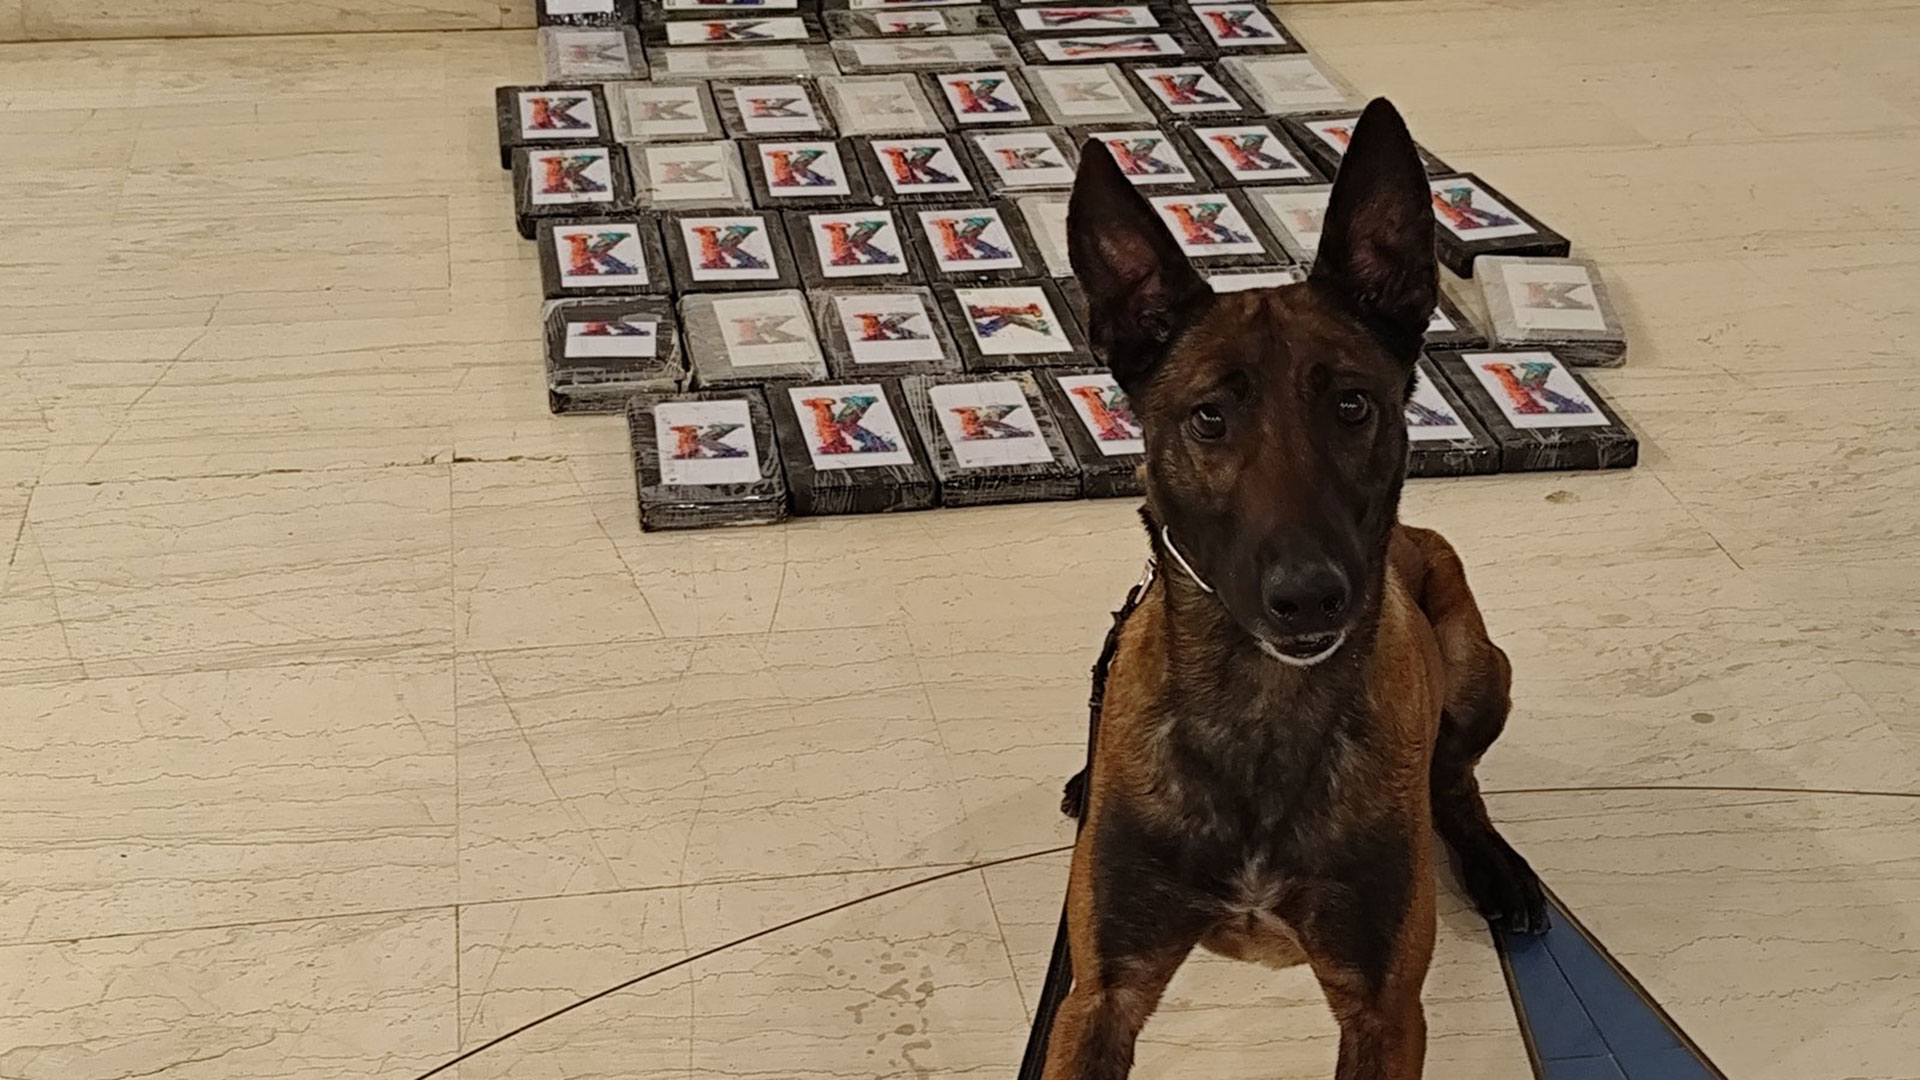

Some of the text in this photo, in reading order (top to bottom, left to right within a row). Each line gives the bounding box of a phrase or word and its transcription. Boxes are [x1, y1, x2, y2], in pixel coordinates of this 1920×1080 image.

[703, 20, 775, 41] K
[1203, 10, 1274, 39] K
[747, 97, 809, 118] K
[948, 79, 1021, 113] K
[1149, 73, 1230, 105] K
[527, 97, 593, 130] K
[642, 100, 699, 121] K
[764, 149, 838, 187] K
[880, 147, 960, 184] K
[994, 146, 1065, 170] K
[1106, 137, 1185, 175] K
[1210, 133, 1298, 171] K
[536, 154, 609, 194] K
[659, 159, 722, 183] K
[1162, 202, 1255, 245] K
[1430, 186, 1520, 230] K
[562, 231, 641, 276] K
[690, 224, 771, 270] K
[821, 219, 901, 266] K
[929, 216, 1013, 261] K
[1522, 281, 1596, 311] K
[730, 314, 807, 346] K
[853, 312, 931, 342] K
[1480, 361, 1596, 415] K
[668, 423, 750, 459] K
[801, 395, 902, 455] K
[948, 403, 1036, 442] K
